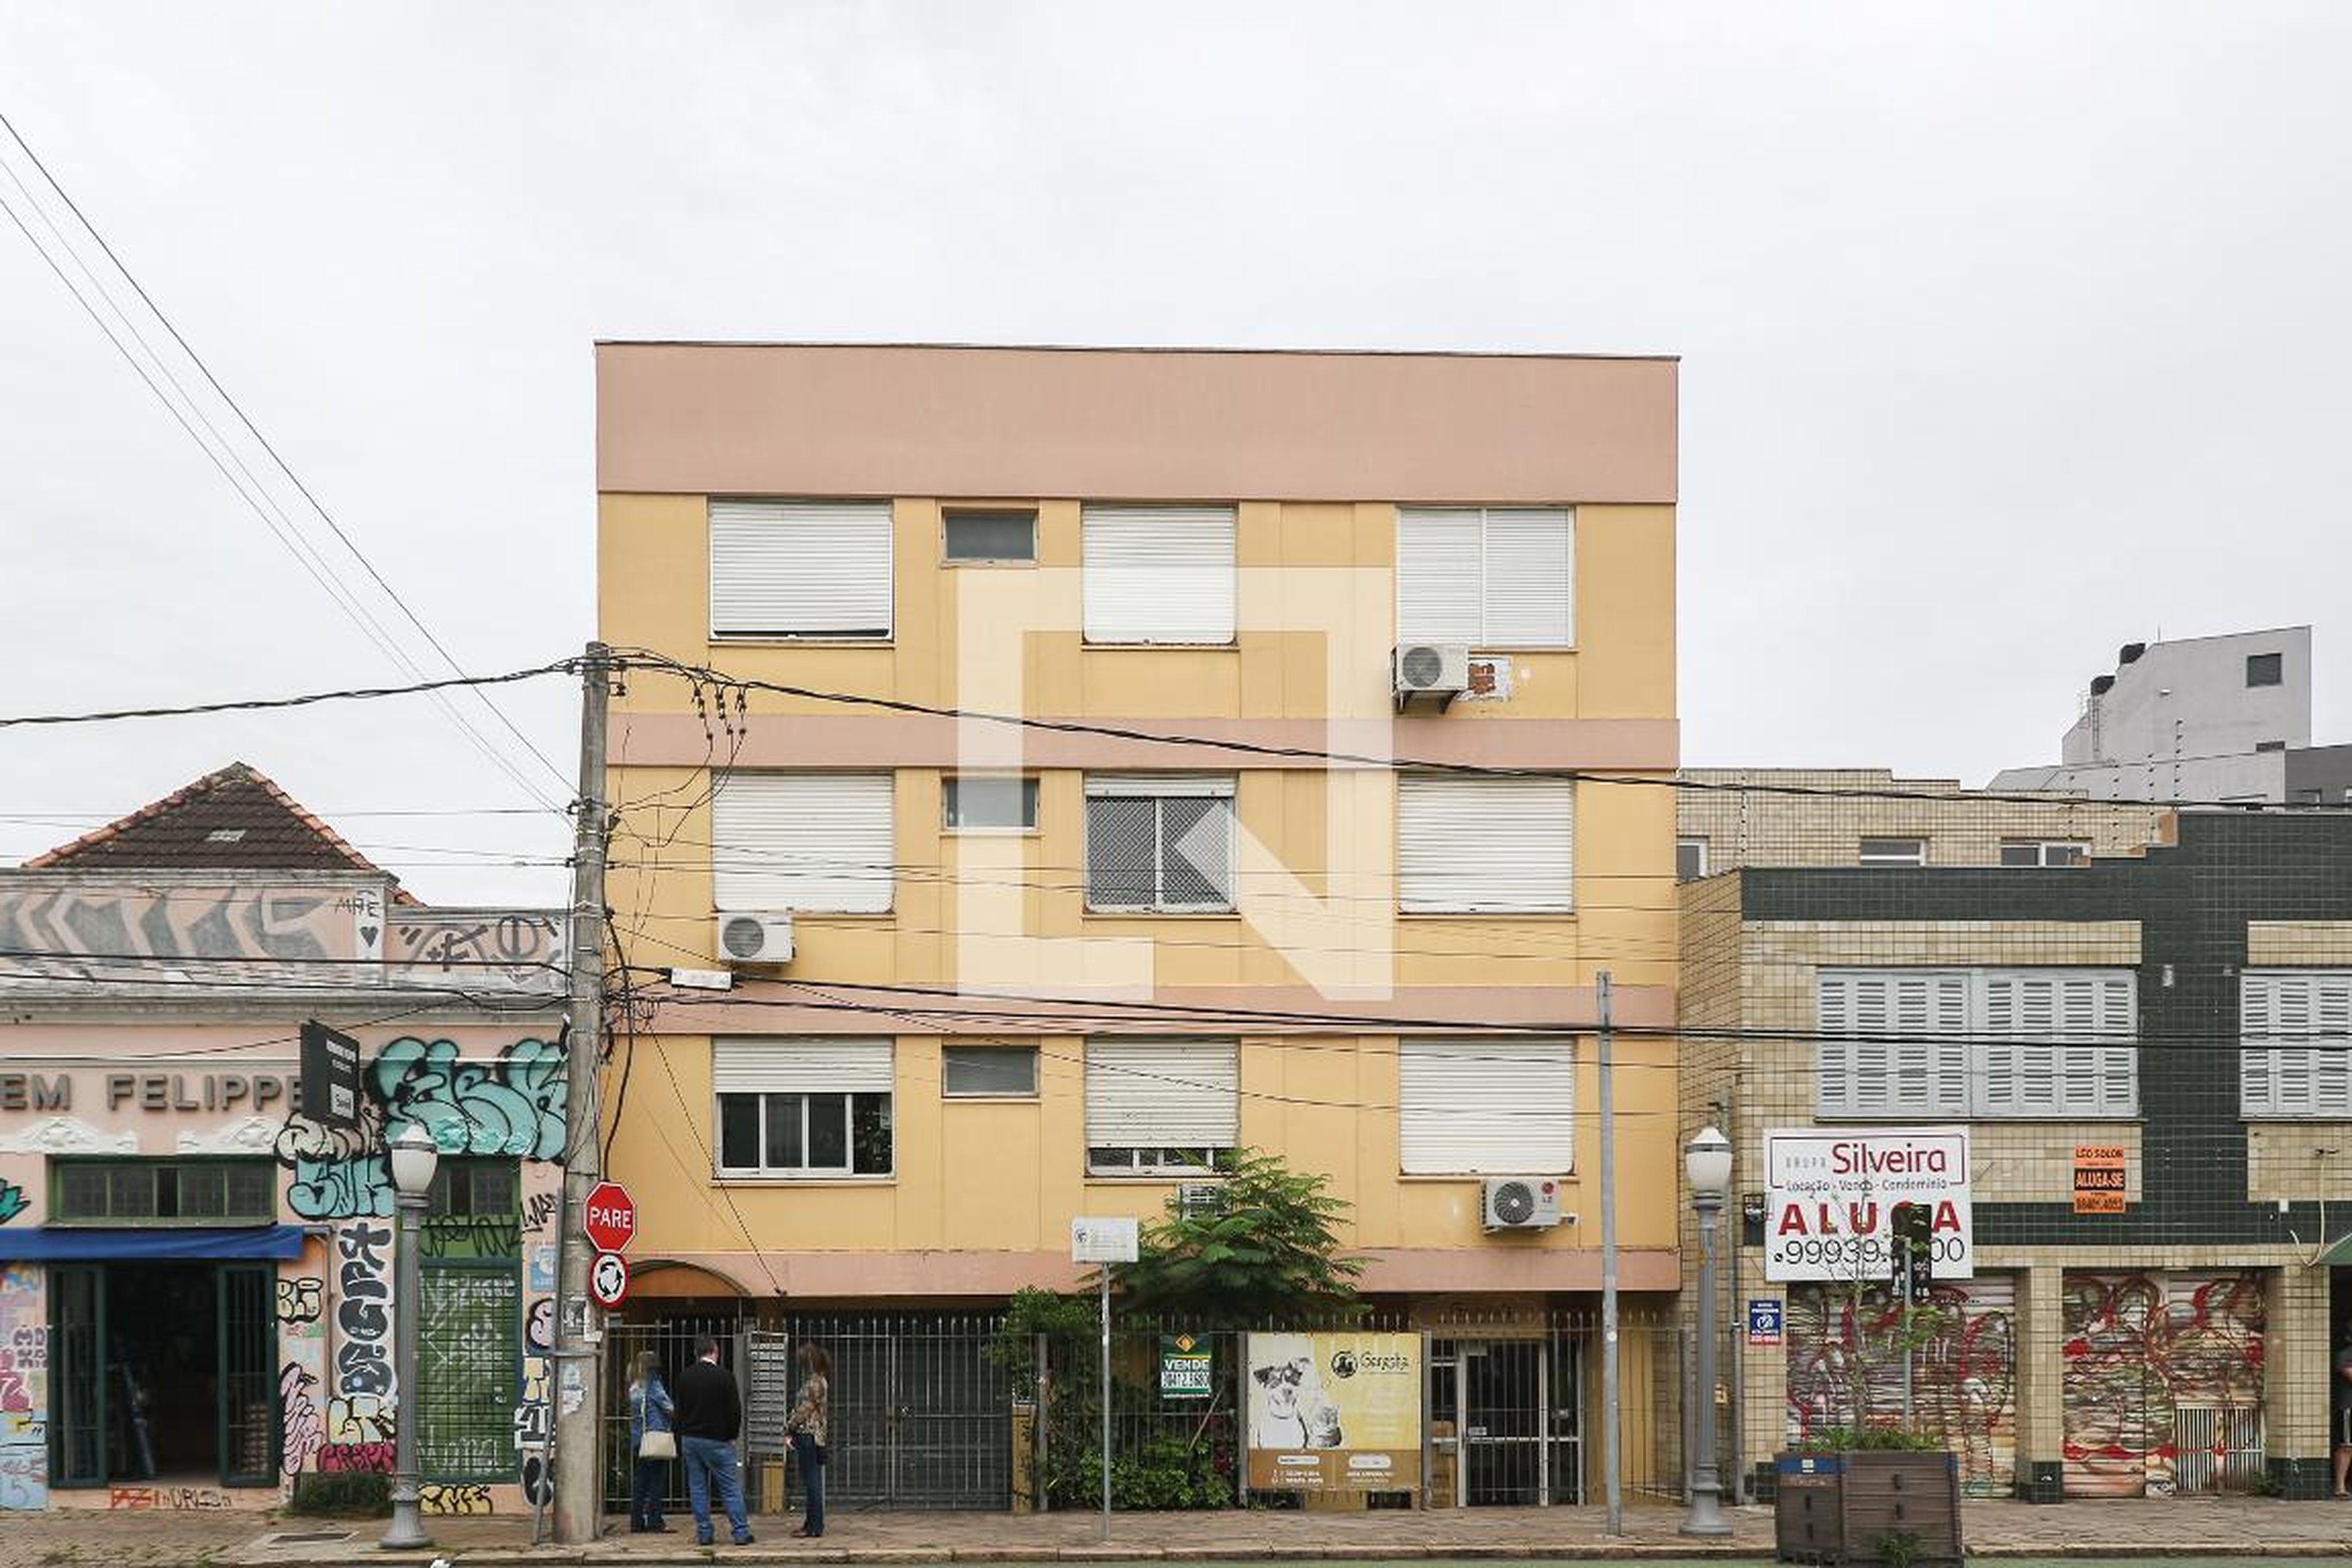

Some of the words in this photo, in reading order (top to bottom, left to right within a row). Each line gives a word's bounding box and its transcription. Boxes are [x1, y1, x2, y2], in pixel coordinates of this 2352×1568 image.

[1832, 1142, 1947, 1175] Silveira
[1786, 1180, 1830, 1193] Locação
[2076, 1171, 2124, 1188] ALUGA-SE
[589, 1205, 631, 1229] PARE
[1778, 1200, 1961, 1236] ALUA
[1164, 1359, 1210, 1371] VENDE
